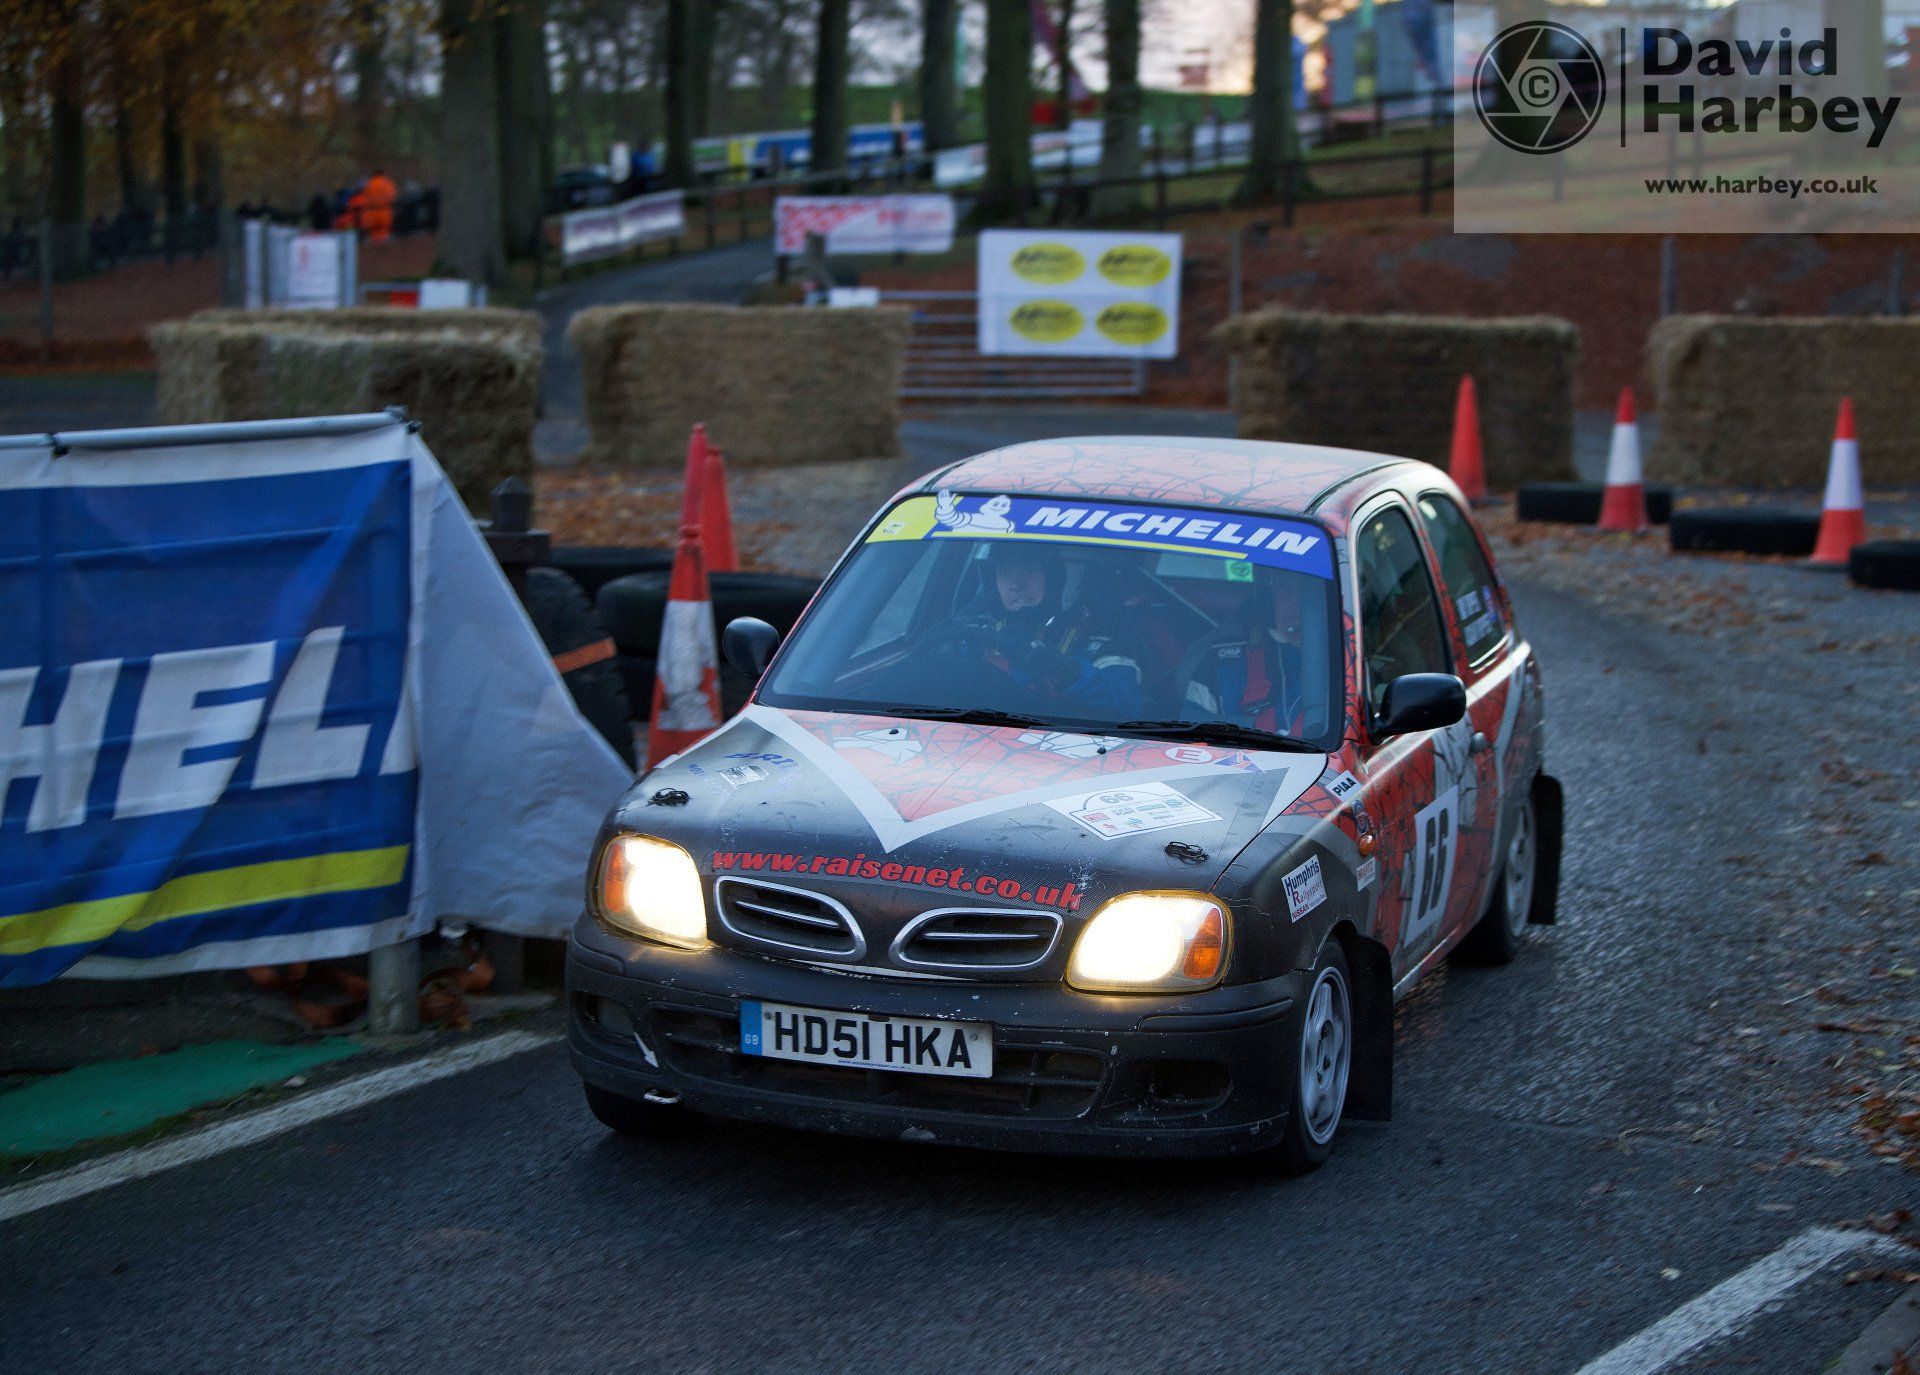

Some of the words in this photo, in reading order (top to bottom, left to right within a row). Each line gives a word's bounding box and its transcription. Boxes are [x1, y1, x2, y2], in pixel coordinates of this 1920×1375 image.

[1025, 507, 1320, 556] MICHELIN
[1099, 792, 1133, 804] 66
[1331, 776, 1357, 797] PIAA
[711, 850, 1082, 911] www.raisenet.co.uk
[1285, 860, 1320, 896] Humphris
[744, 1033, 759, 1046] GB
[775, 1011, 870, 1061] HD51
[885, 1023, 972, 1069] HKA
